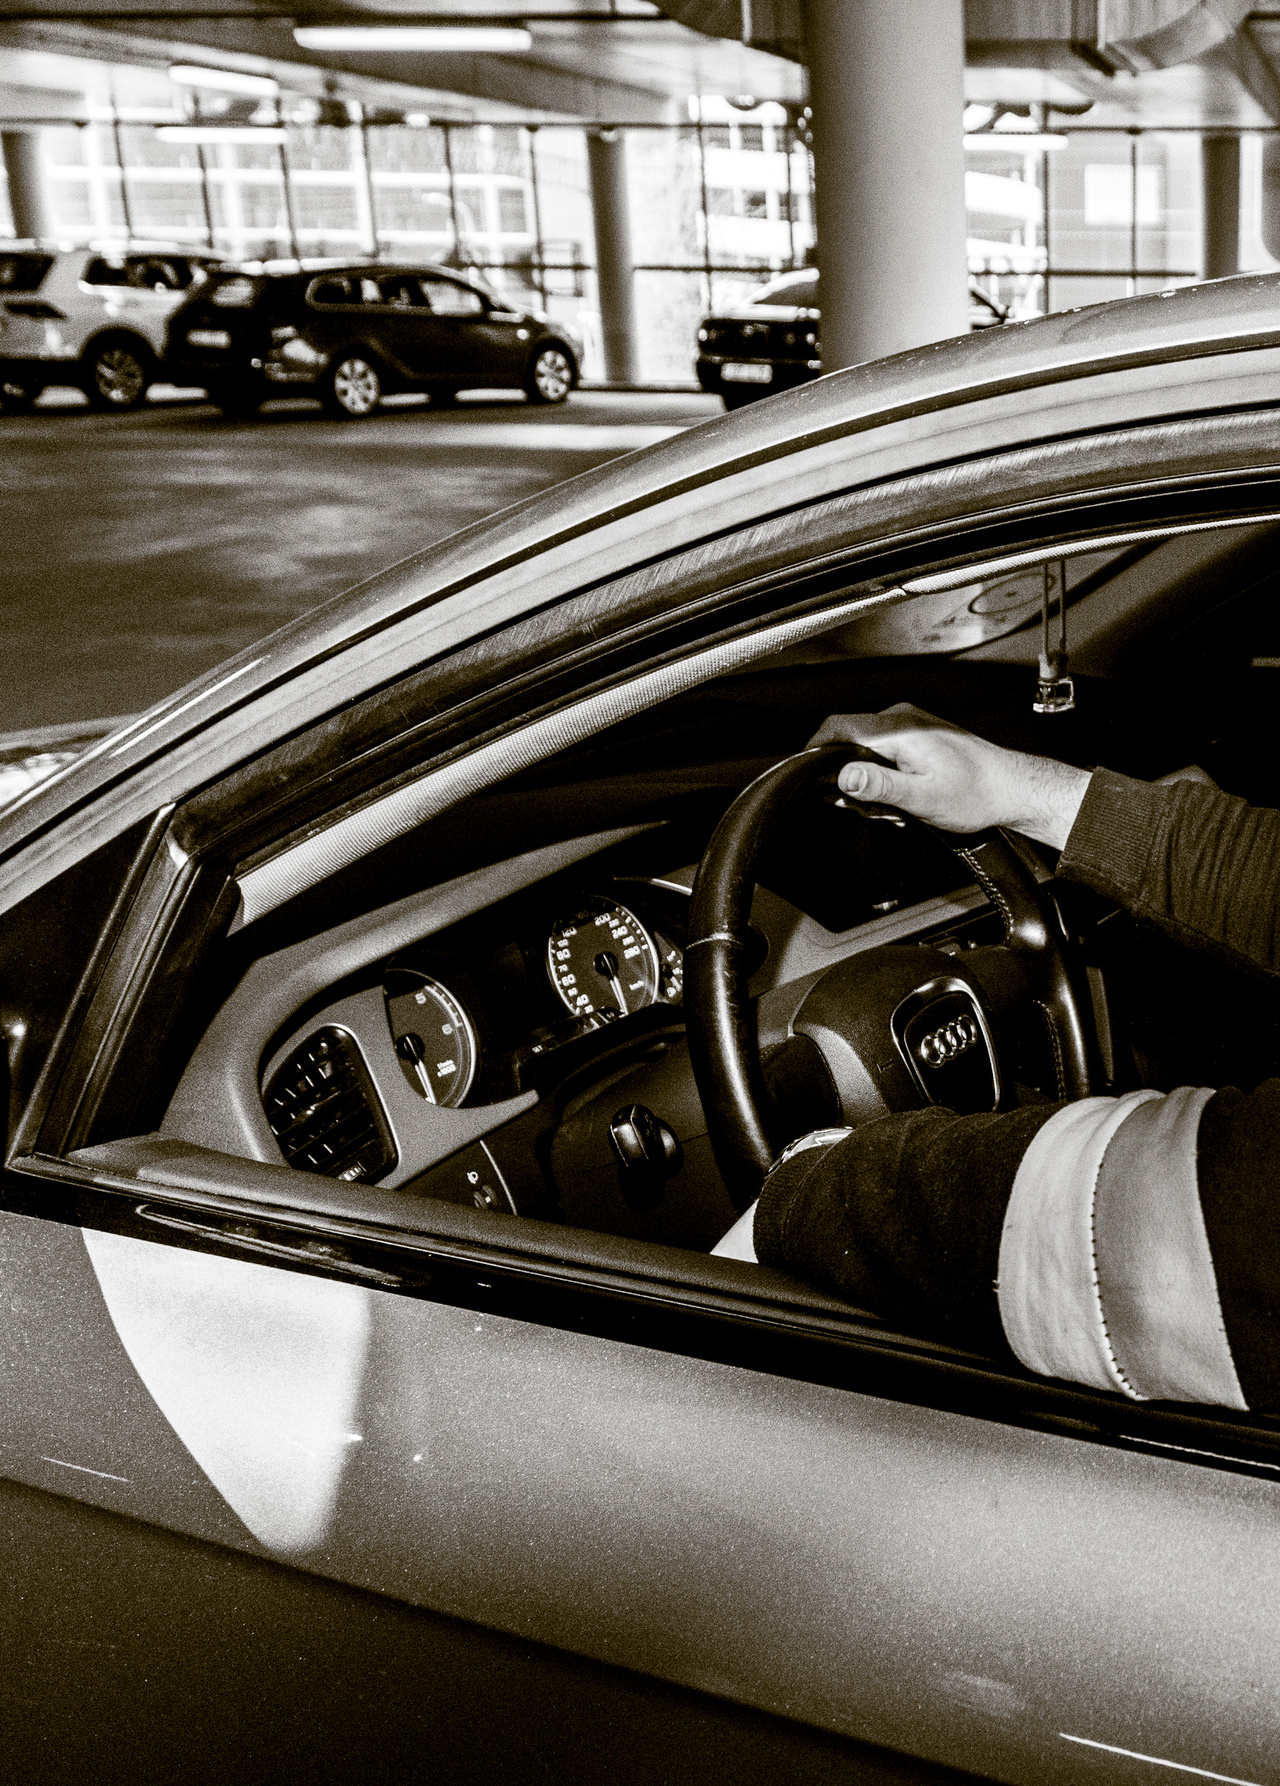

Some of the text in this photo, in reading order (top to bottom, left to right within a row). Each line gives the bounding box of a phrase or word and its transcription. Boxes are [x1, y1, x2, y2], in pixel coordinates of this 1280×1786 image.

[594, 913, 611, 926] 200
[613, 925, 628, 939] 240
[577, 994, 589, 1006] 40
